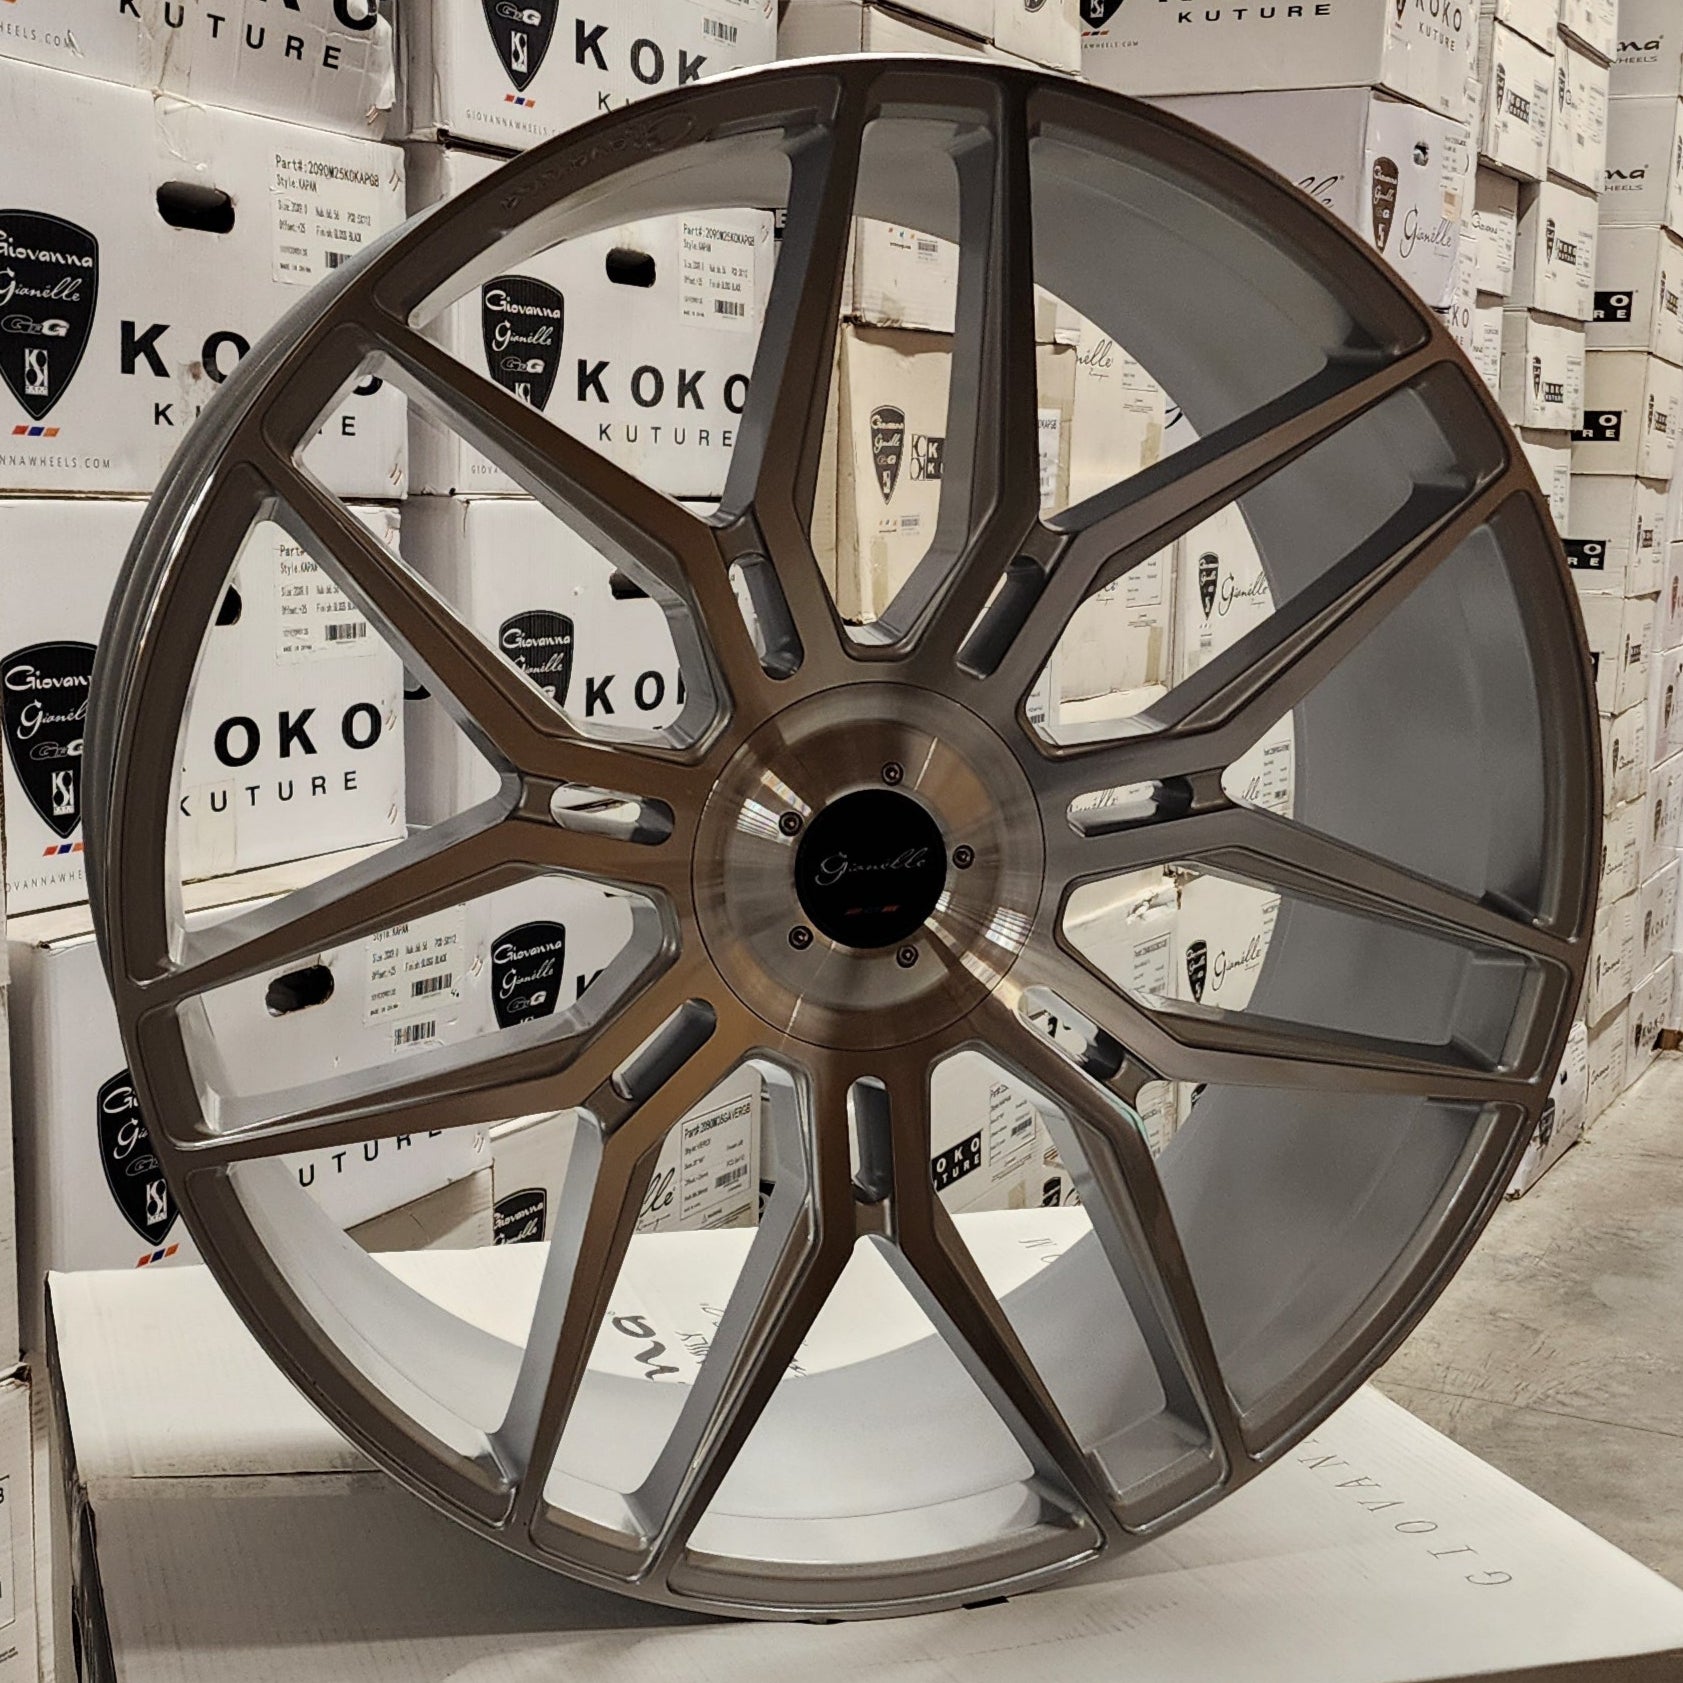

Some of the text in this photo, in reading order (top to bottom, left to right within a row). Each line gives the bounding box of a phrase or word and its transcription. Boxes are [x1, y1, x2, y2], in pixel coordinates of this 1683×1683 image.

[1178, 3, 1331, 23] KUTURE
[119, 0, 342, 70] KUTURE
[1418, 21, 1455, 52] KUTURE
[574, 18, 708, 86] KOK
[1616, 55, 1658, 64] HEELS
[465, 109, 558, 138] GIOVANNAWHEELS.C
[1604, 184, 1643, 192] HEELS
[485, 289, 561, 319] Giovanna
[576, 358, 751, 414] KOKO
[598, 422, 734, 448] KUTURE
[502, 627, 571, 649] Giovanna
[4, 664, 94, 692] Giovan
[585, 667, 685, 718] KO
[213, 701, 383, 768] OKO
[180, 770, 358, 818] KUTURE
[493, 940, 563, 965] Giovanna
[298, 1130, 442, 1188] UTUR
[935, 1136, 980, 1174] OKO
[932, 1153, 980, 1190] TURE
